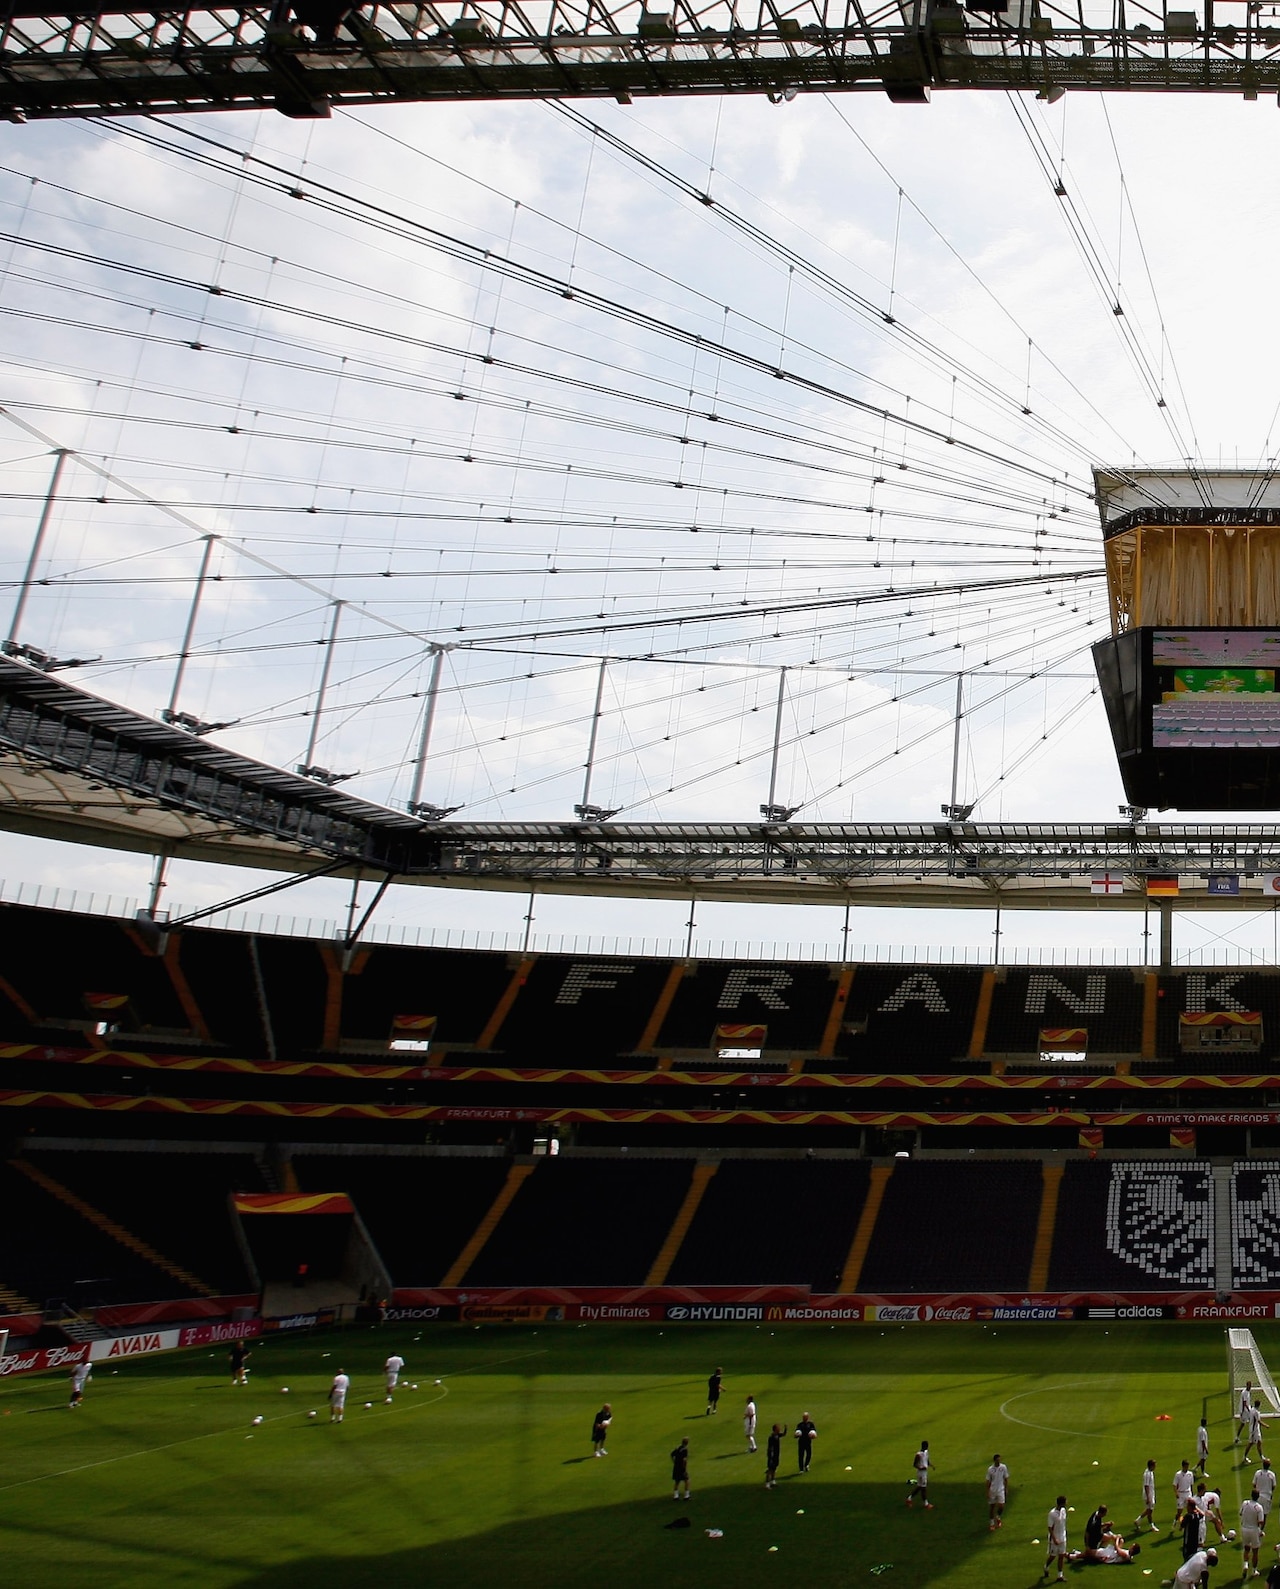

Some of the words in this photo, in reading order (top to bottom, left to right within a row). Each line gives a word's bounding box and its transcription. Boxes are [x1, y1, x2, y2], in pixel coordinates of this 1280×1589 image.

[447, 1109, 511, 1119] FRANKFURT
[1147, 1115, 1155, 1123] A
[1156, 1115, 1181, 1123] TIME
[1183, 1115, 1196, 1123] TO
[1198, 1114, 1227, 1123] MAKE
[1229, 1114, 1270, 1123] FRIENDS
[382, 1307, 440, 1320] YAHOO!
[580, 1305, 599, 1319] Fly
[600, 1306, 650, 1318] Emirates
[690, 1307, 763, 1320] HYUNDAI
[785, 1307, 860, 1319] McDonald's
[994, 1307, 1057, 1320] MasterCard
[1118, 1305, 1163, 1318] adidas
[1193, 1305, 1269, 1317] FRANKFURT
[108, 1334, 161, 1357] AVAYA
[46, 1342, 84, 1367] Bud
[0, 1352, 40, 1375] Bud
